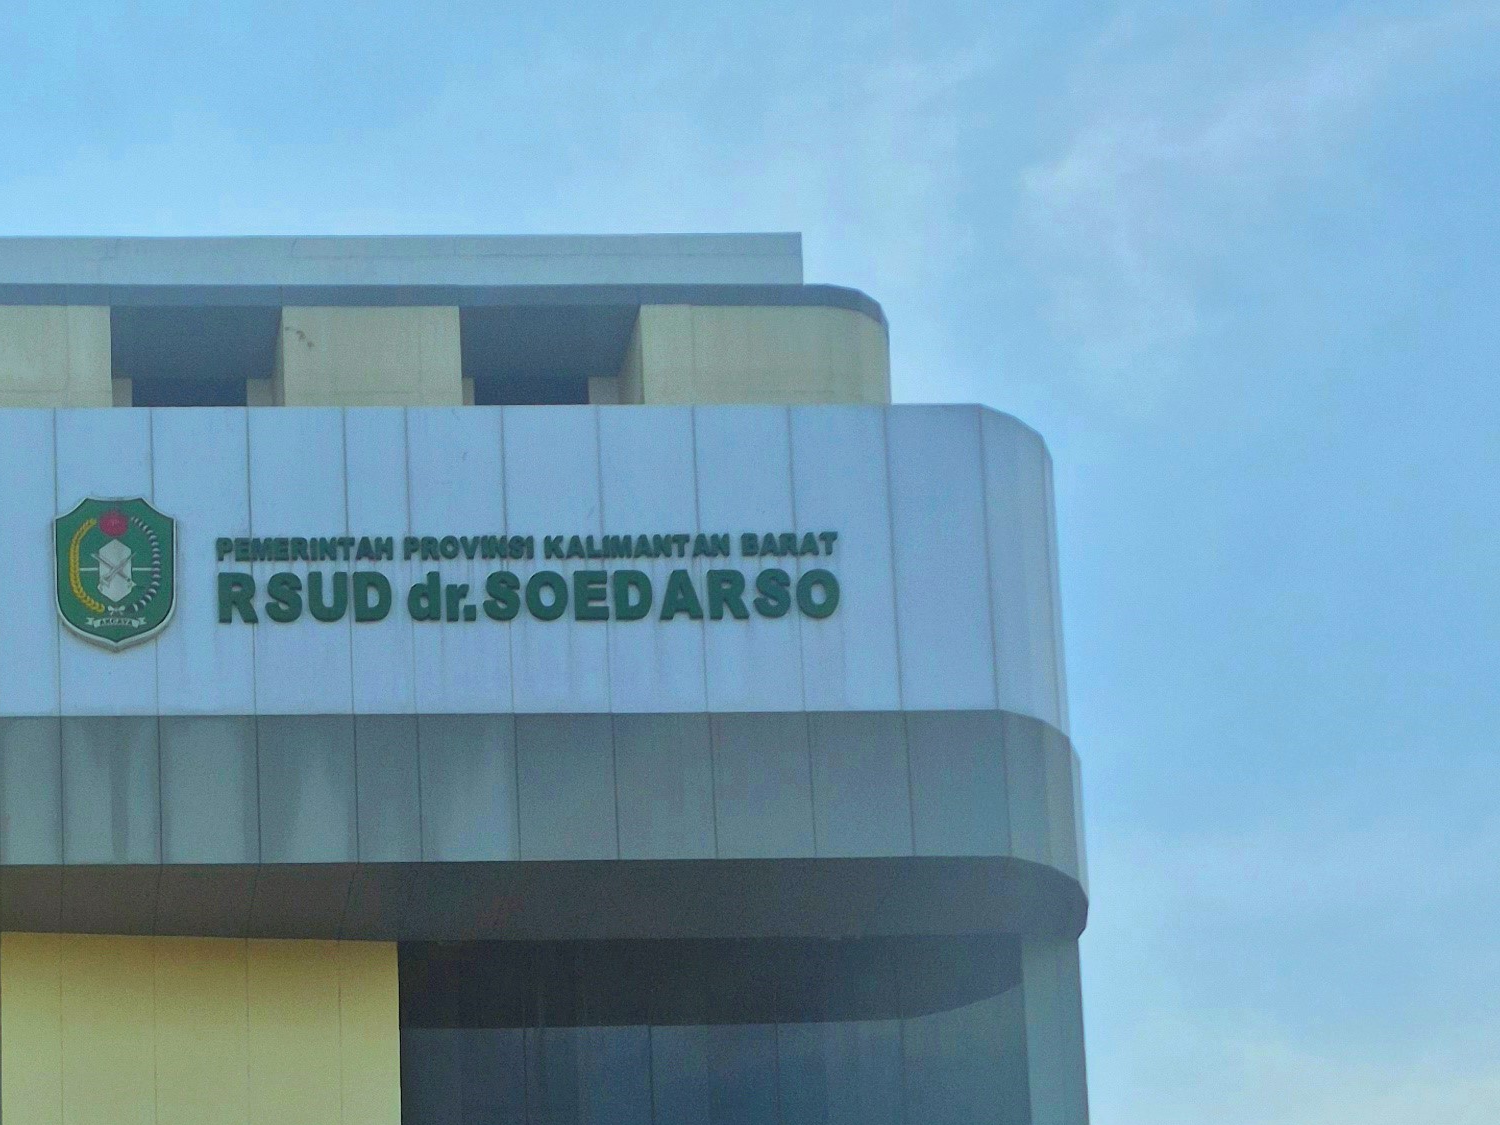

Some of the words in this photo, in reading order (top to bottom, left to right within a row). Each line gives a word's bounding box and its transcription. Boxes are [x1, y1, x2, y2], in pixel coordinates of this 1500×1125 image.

[215, 536, 394, 562] PEMERINTAH
[403, 534, 534, 561] PROVINSI
[543, 532, 731, 559] KALIMANTAN
[740, 531, 839, 557] BARAT
[217, 571, 393, 624] RSUD
